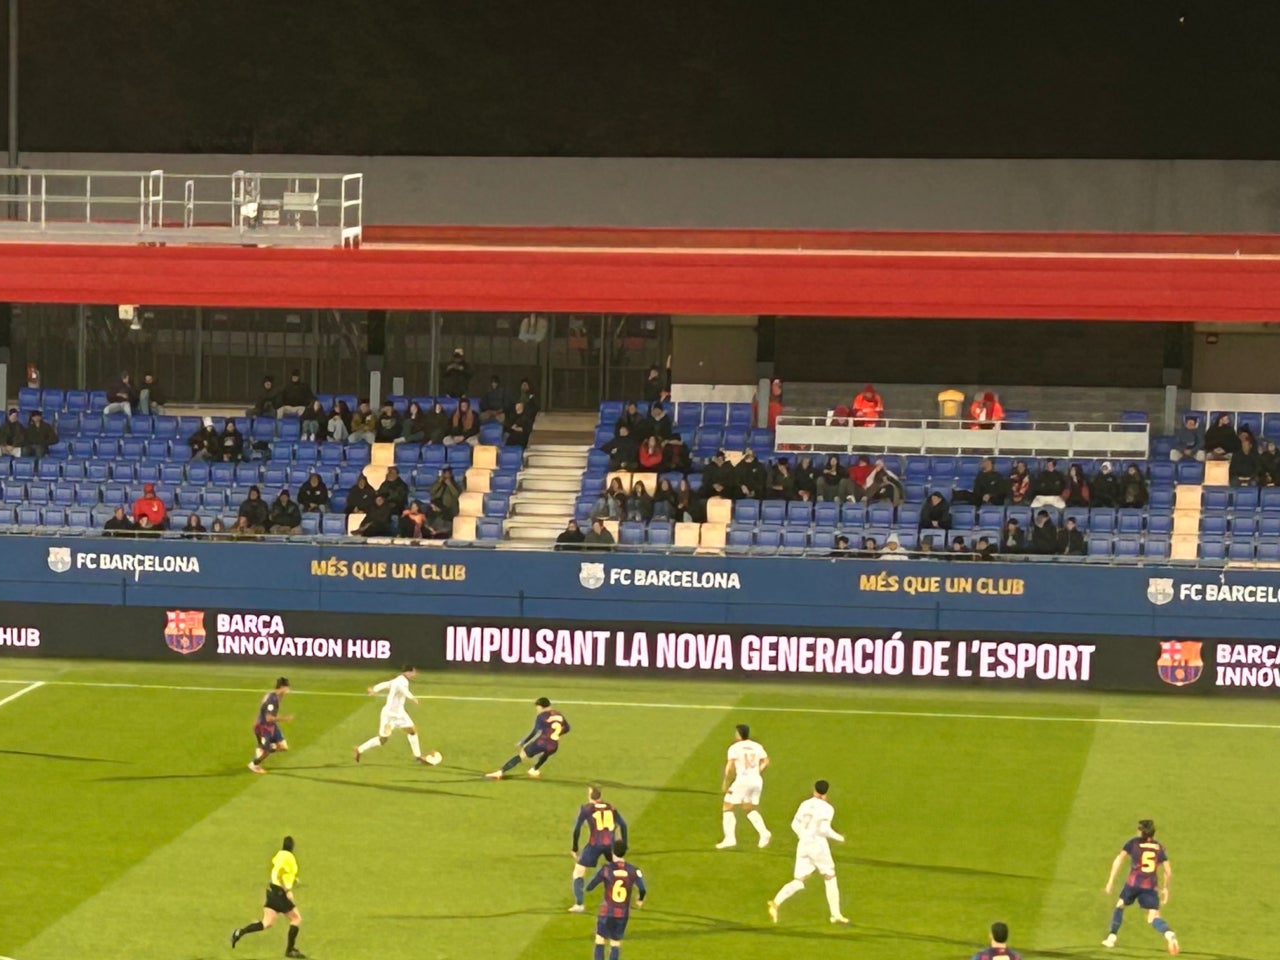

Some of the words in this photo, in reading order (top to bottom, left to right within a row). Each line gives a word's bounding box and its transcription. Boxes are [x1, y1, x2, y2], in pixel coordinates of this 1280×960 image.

[76, 552, 97, 569] FC
[100, 554, 200, 574] BARCELONA
[311, 556, 348, 576] MÉS
[352, 561, 387, 580] QUE
[392, 563, 417, 579] UN
[421, 564, 466, 581] CLUB
[610, 568, 631, 586] FC
[634, 569, 741, 590] BARCELONA
[859, 571, 899, 592] MÉS
[903, 576, 941, 595] QUE
[945, 577, 972, 594] UN
[977, 578, 1024, 595] CLUB
[1180, 584, 1202, 601] FC
[1206, 584, 1280, 603] BARCEL
[217, 614, 285, 636] BARÇA
[217, 635, 342, 658] INNOVATION
[347, 639, 391, 659] HUB
[446, 626, 610, 666] IMPULSANT
[616, 632, 649, 668] LA
[656, 633, 734, 670] NOVA
[740, 631, 905, 676] GENERACIÓ
[912, 641, 951, 677] DE
[957, 640, 1096, 681] L'ESPORT
[550, 721, 562, 741] 2
[592, 810, 615, 832] 14
[1141, 851, 1156, 873] 5
[612, 880, 627, 903] 6
